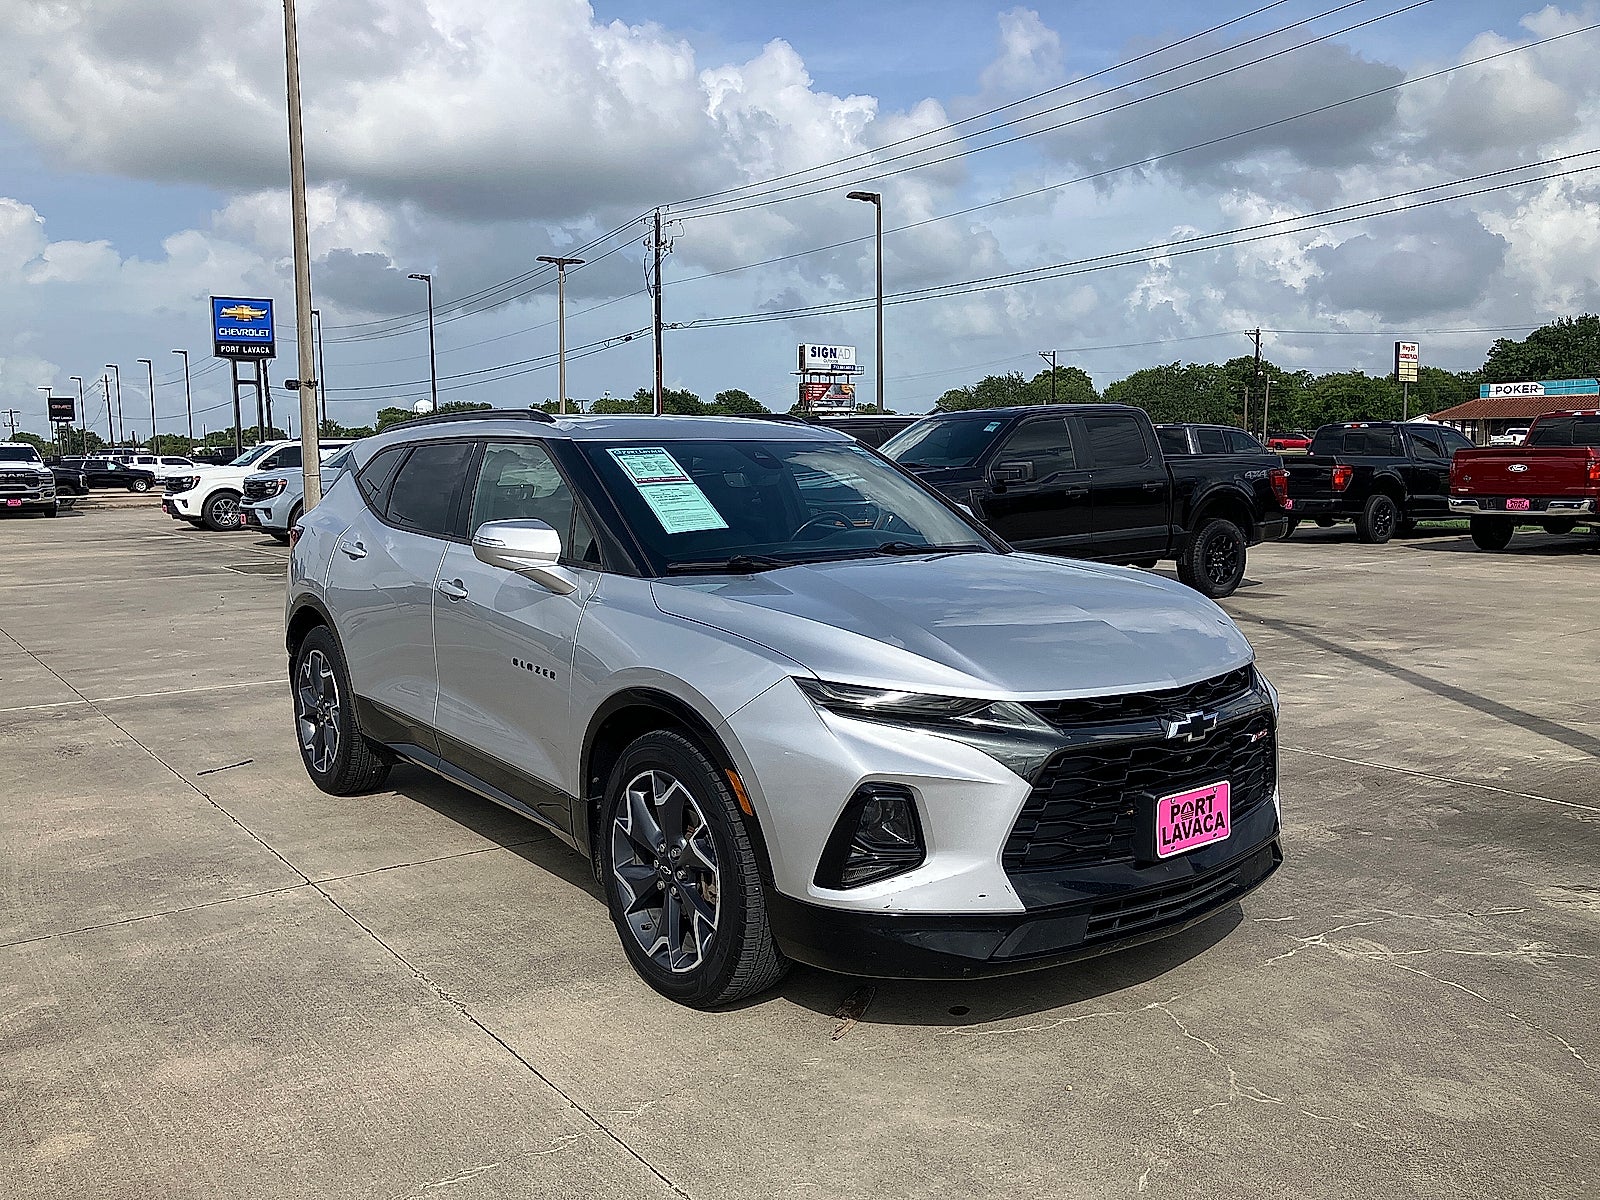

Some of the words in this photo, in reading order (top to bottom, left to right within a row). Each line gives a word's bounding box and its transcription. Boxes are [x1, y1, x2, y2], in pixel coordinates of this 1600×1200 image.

[218, 327, 270, 337] CHEVROLET
[220, 345, 240, 353] PORT
[242, 346, 270, 354] LAVACA
[1495, 384, 1539, 395] POKER
[512, 657, 556, 681] BLAZER
[1170, 794, 1216, 824] PORT
[1162, 811, 1226, 846] LAVACA
